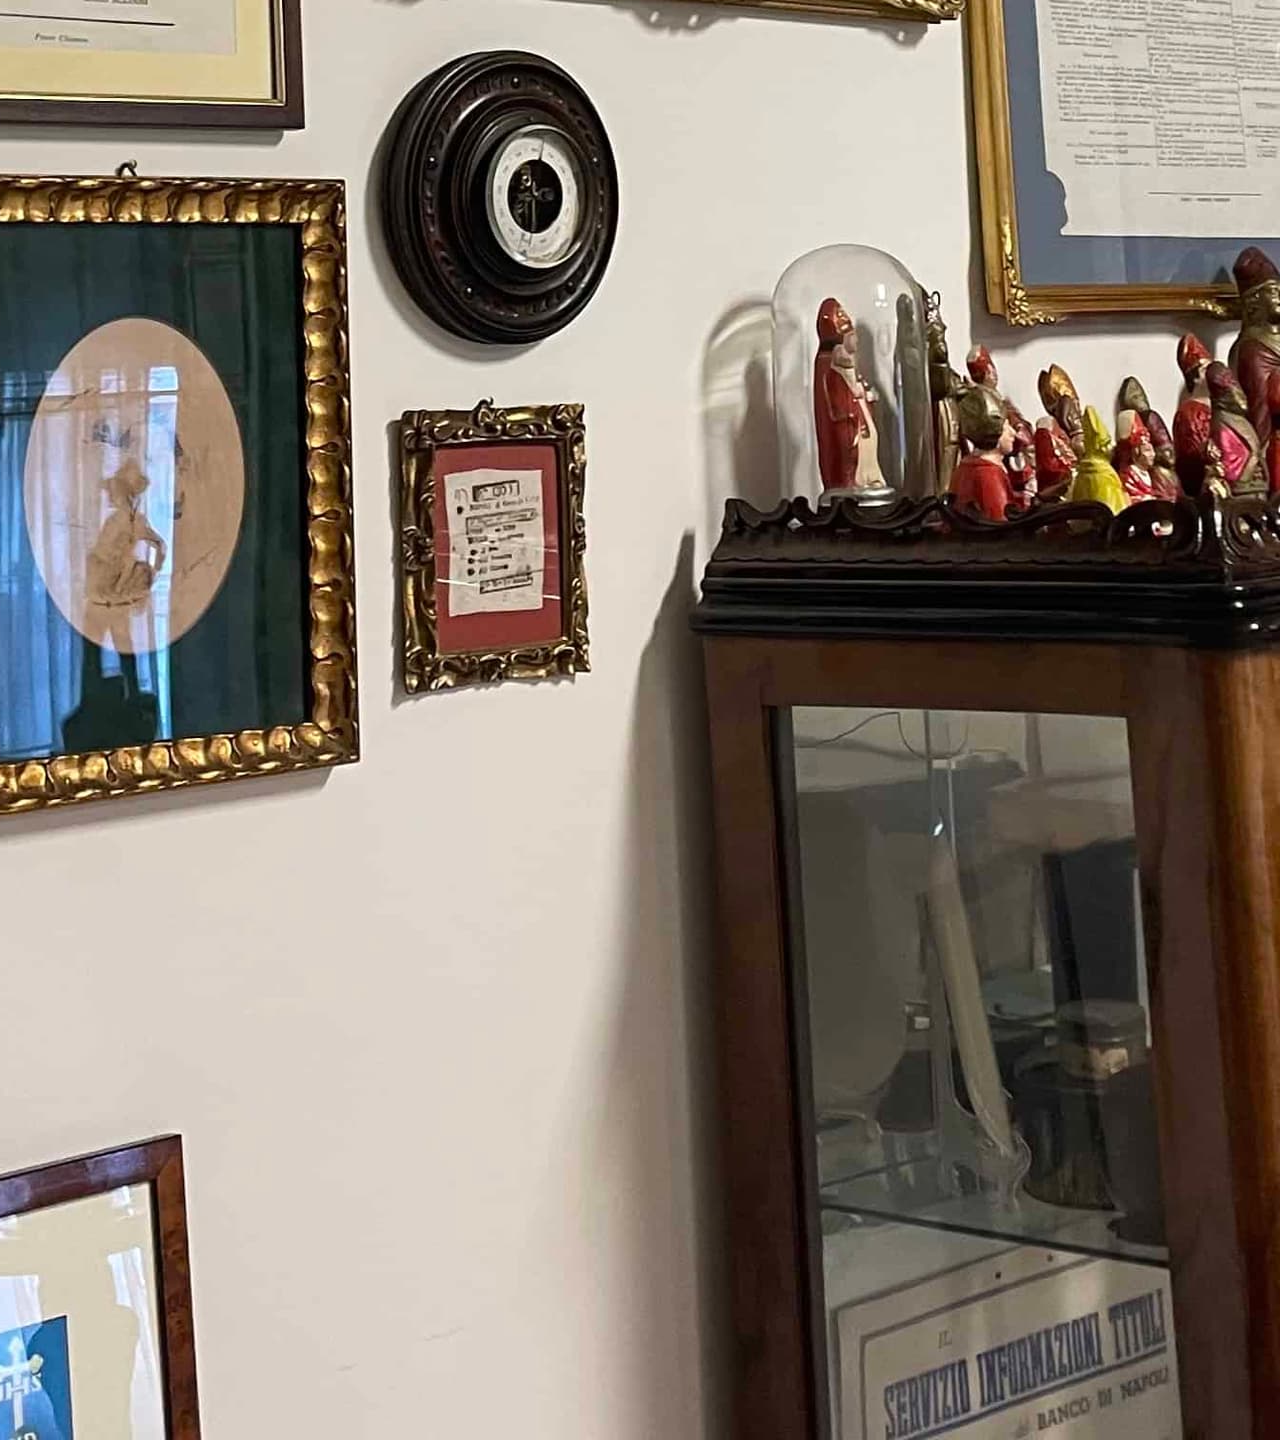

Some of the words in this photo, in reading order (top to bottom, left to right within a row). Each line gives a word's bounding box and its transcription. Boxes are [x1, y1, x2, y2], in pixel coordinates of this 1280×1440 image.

[883, 1358, 971, 1439] SERVIZIO
[977, 1312, 1102, 1407] INFORMAZIONI
[1108, 1288, 1166, 1359] TITOLI
[1037, 1392, 1091, 1429] BANCO
